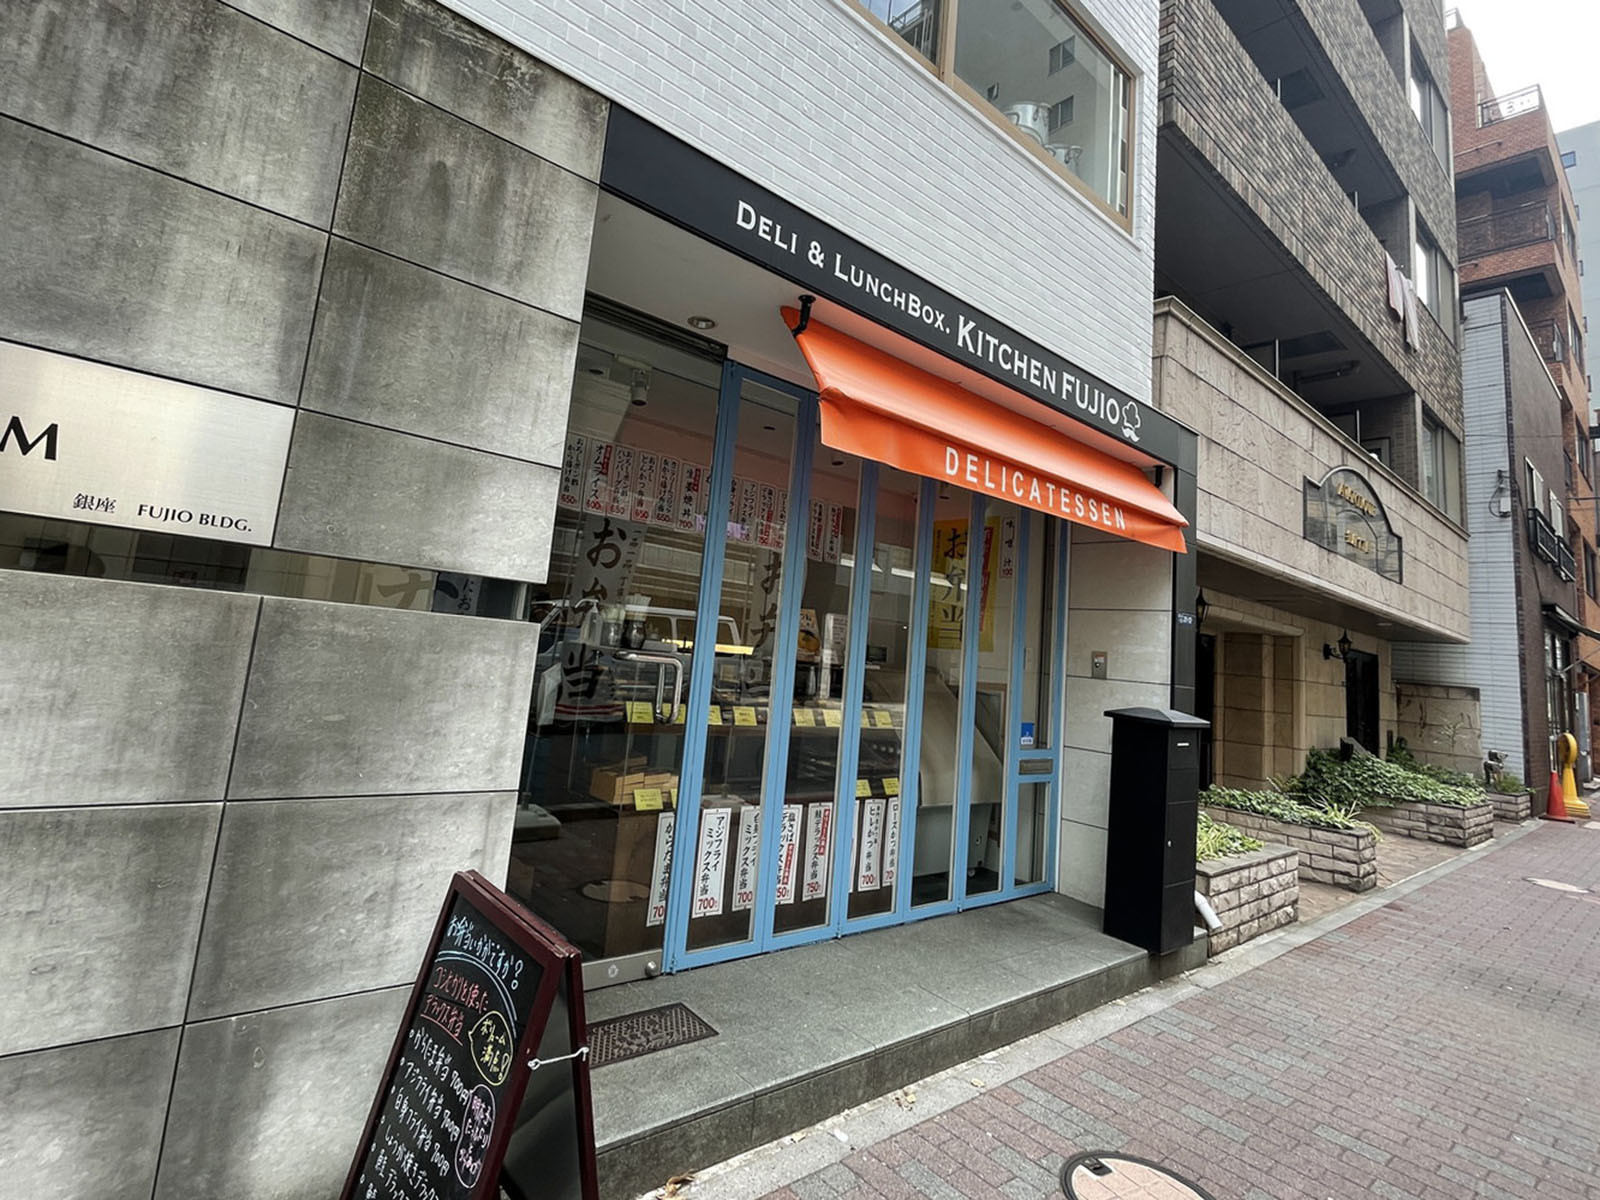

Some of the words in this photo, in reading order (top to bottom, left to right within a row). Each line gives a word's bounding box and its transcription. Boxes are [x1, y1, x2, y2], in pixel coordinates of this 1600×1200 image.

[807, 241, 825, 268] &
[956, 314, 1056, 395] KITCHEN
[1061, 371, 1120, 426] FUJIO
[73, 493, 117, 514] 銀座
[137, 504, 193, 523] FUJIO
[199, 513, 252, 532] BLDG.
[945, 446, 1127, 531] DELICATESSEN
[700, 828, 713, 896] ミックス弁当
[711, 816, 725, 872] アジフライ
[740, 824, 752, 889] ミックス弁当
[394, 1086, 434, 1153] 白身フライ弁当
[404, 1061, 445, 1119] アジフライ弁当
